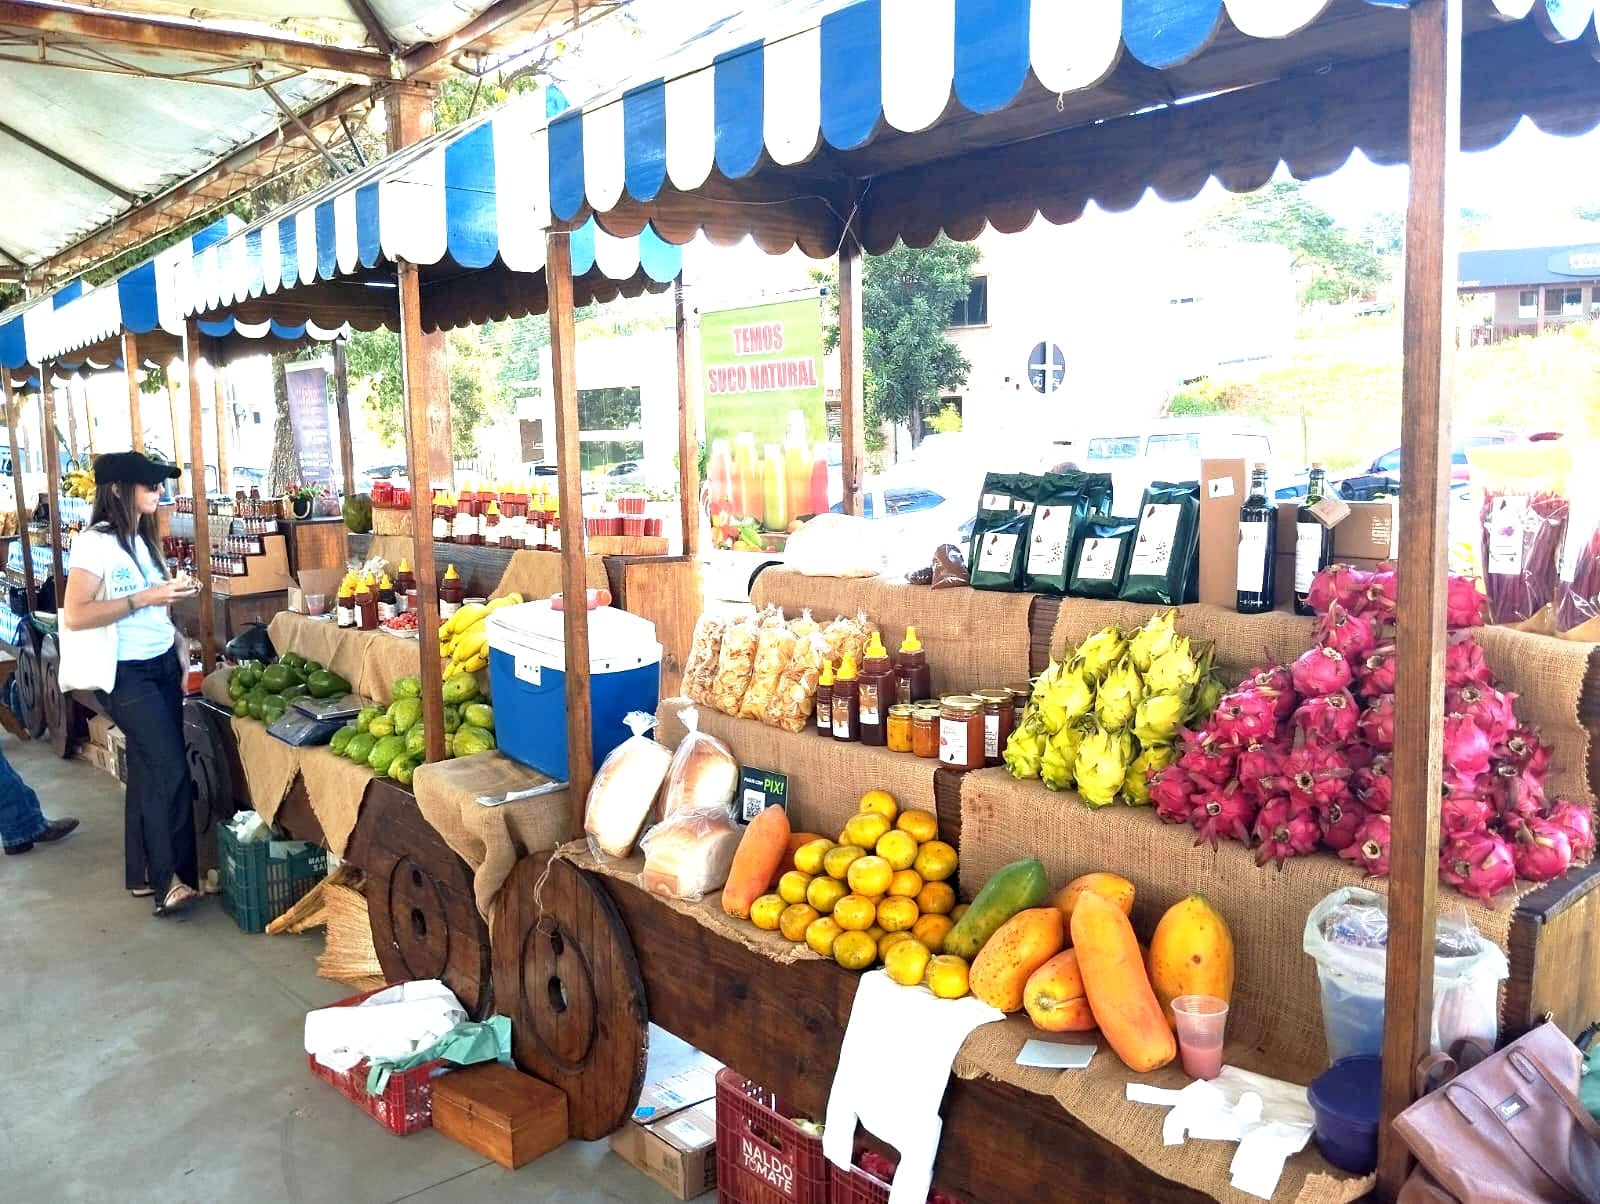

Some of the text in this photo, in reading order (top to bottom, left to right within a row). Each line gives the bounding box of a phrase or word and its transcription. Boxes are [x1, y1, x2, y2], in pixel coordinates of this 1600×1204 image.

[733, 323, 783, 354] TEMOS
[708, 360, 817, 393] SUCO NATURAL
[763, 778, 785, 795] PIX!
[742, 1137, 793, 1180] NALDO
[743, 1152, 793, 1194] TOMATE
